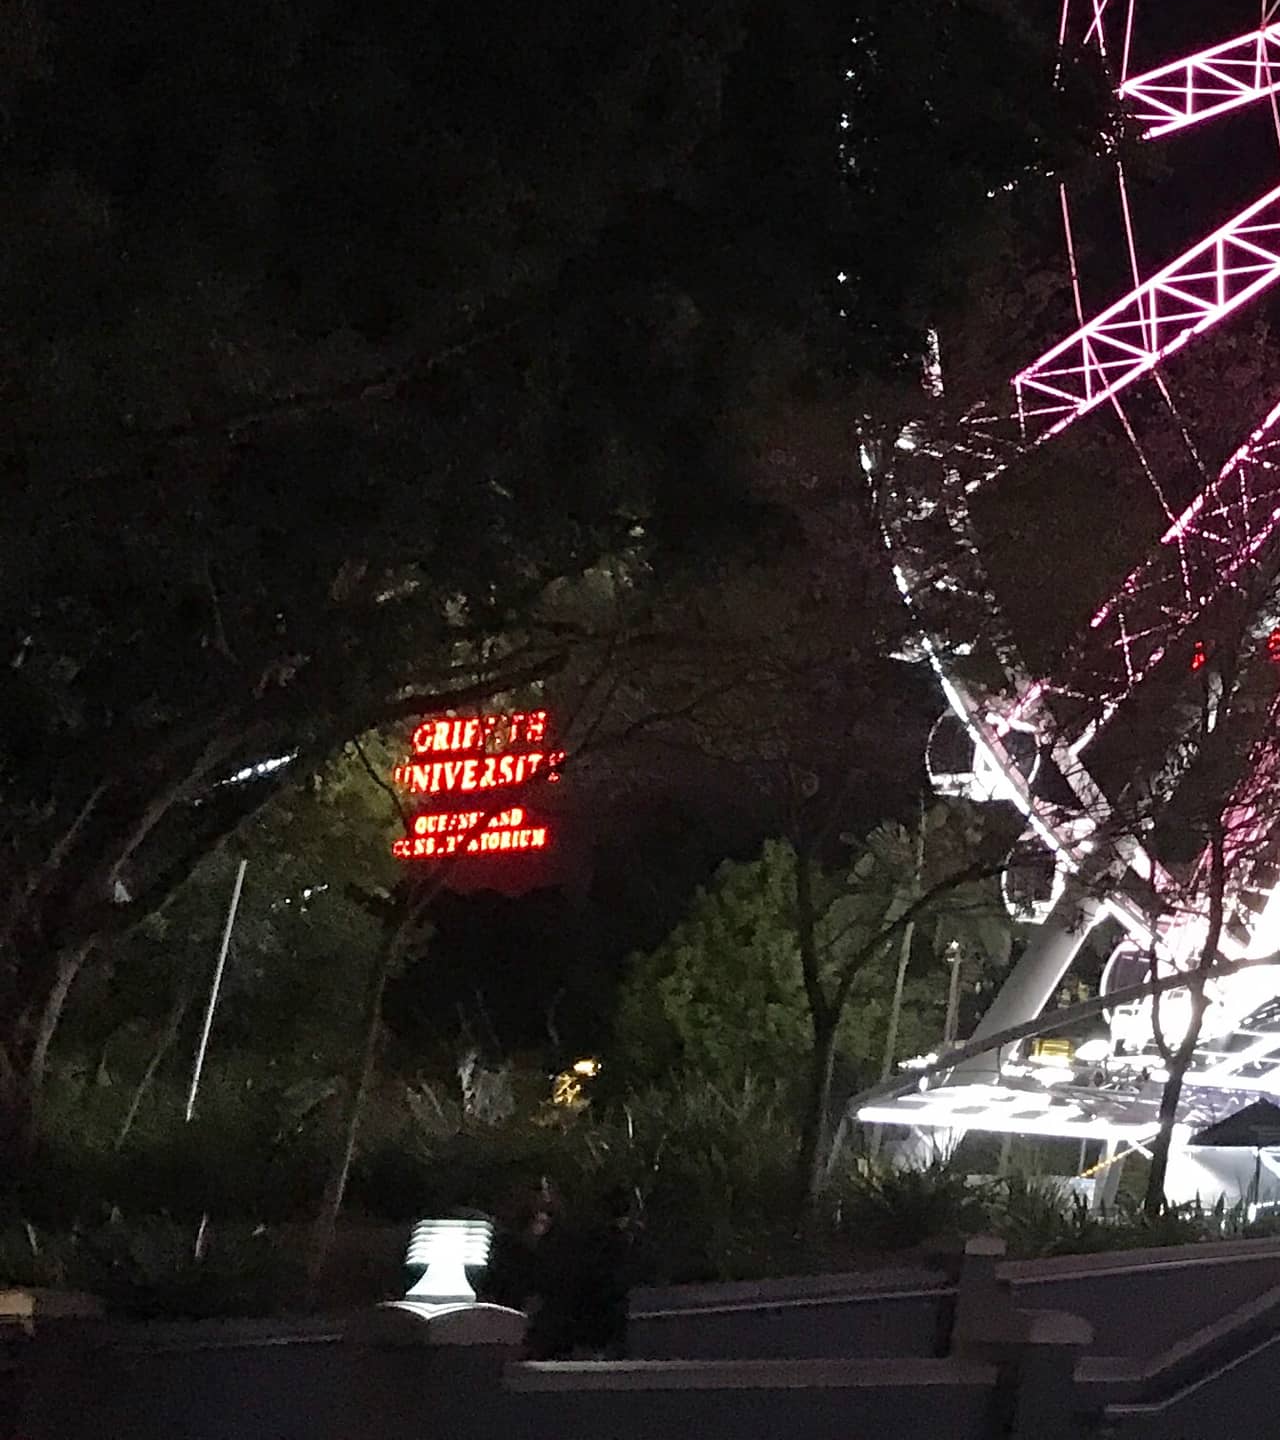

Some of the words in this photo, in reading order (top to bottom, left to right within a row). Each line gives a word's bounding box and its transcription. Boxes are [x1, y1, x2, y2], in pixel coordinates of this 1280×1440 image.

[412, 711, 547, 753] GRIFTH
[413, 809, 524, 835] QUENSAND
[392, 829, 547, 857] CONSRATORIUM
